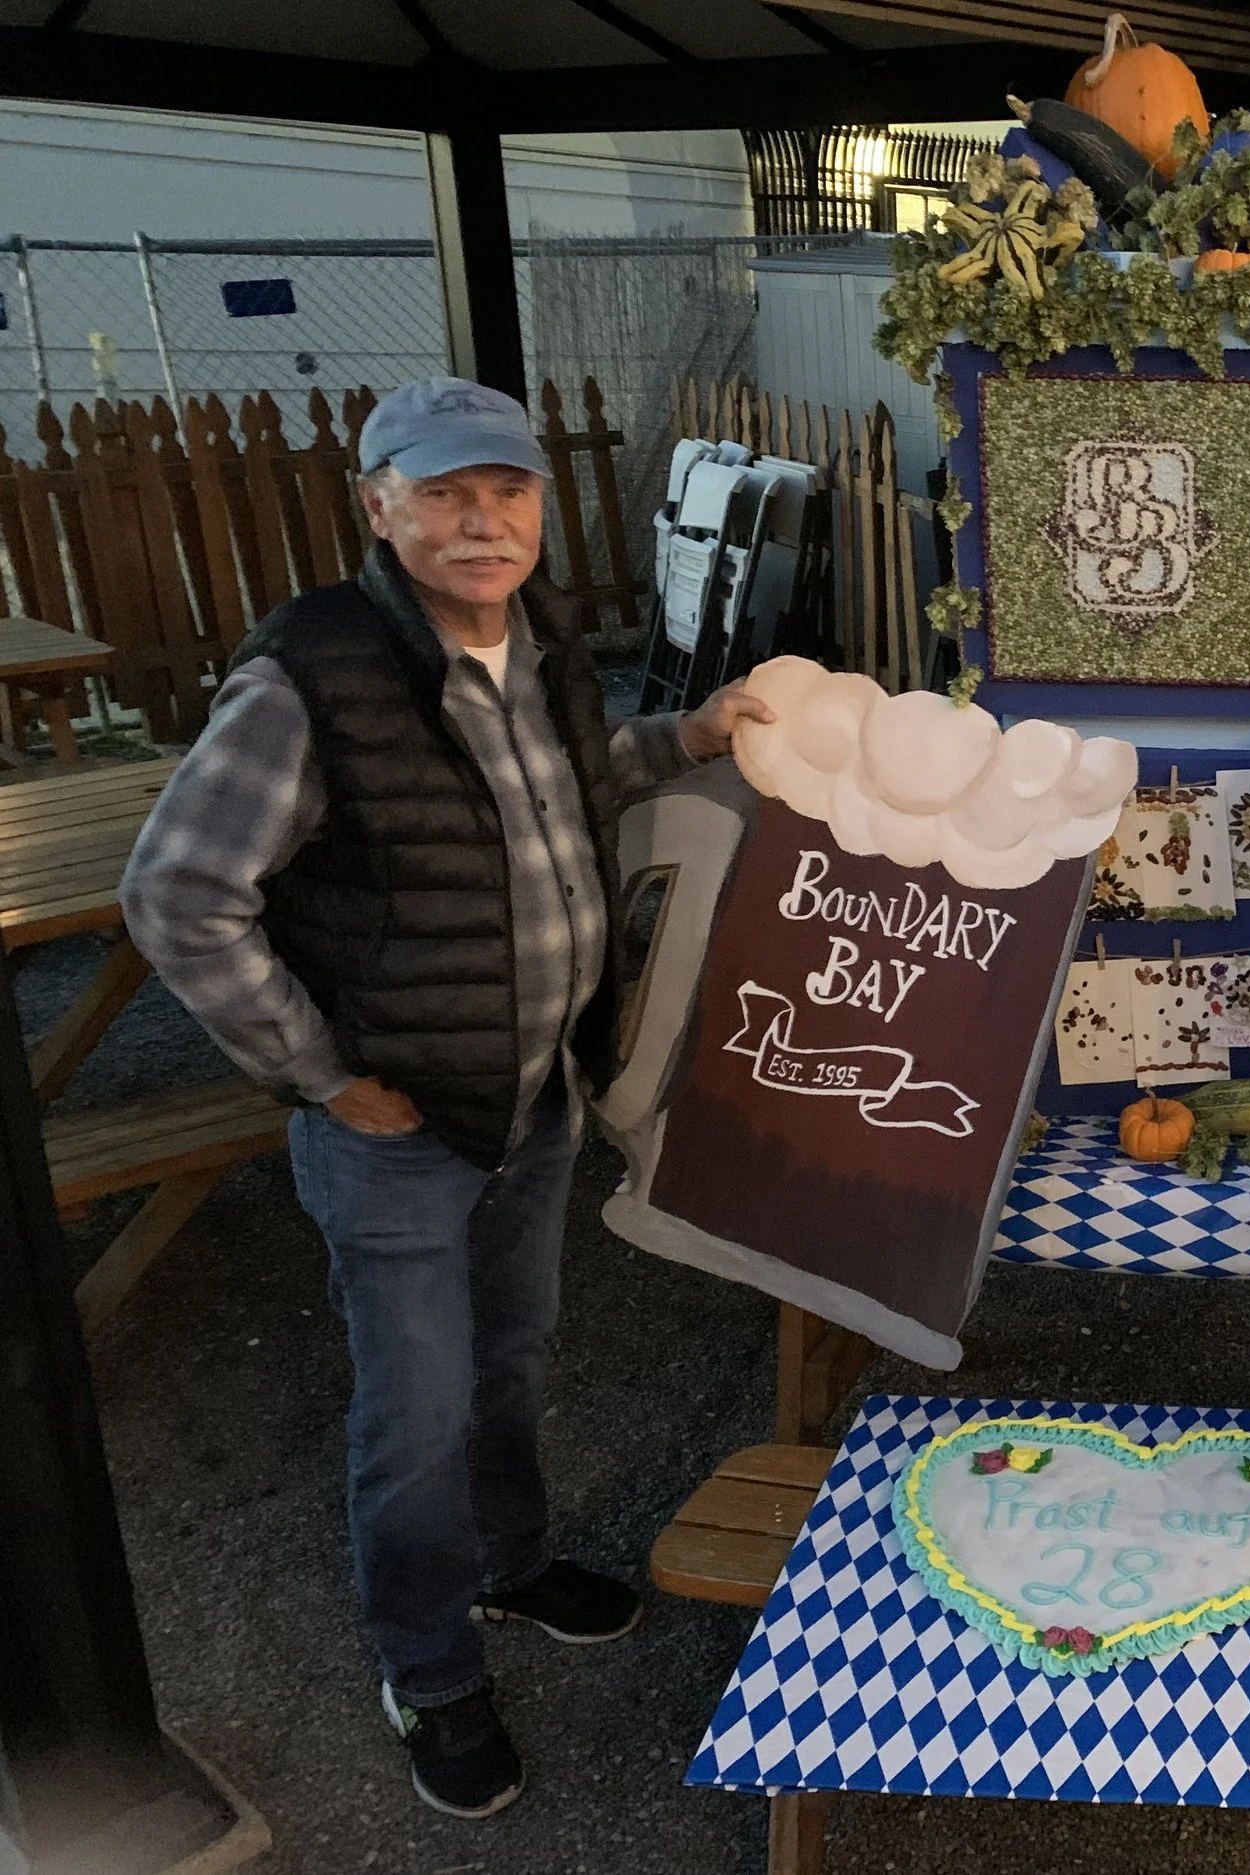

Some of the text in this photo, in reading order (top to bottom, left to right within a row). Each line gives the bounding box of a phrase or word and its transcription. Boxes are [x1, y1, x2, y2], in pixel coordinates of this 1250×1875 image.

[779, 850, 1016, 971] BOUNDARY
[806, 936, 925, 1022] BAY
[767, 1053, 862, 1088] EST. 1995
[981, 1475, 1128, 1533] Prost
[1021, 1543, 1162, 1610] 28
